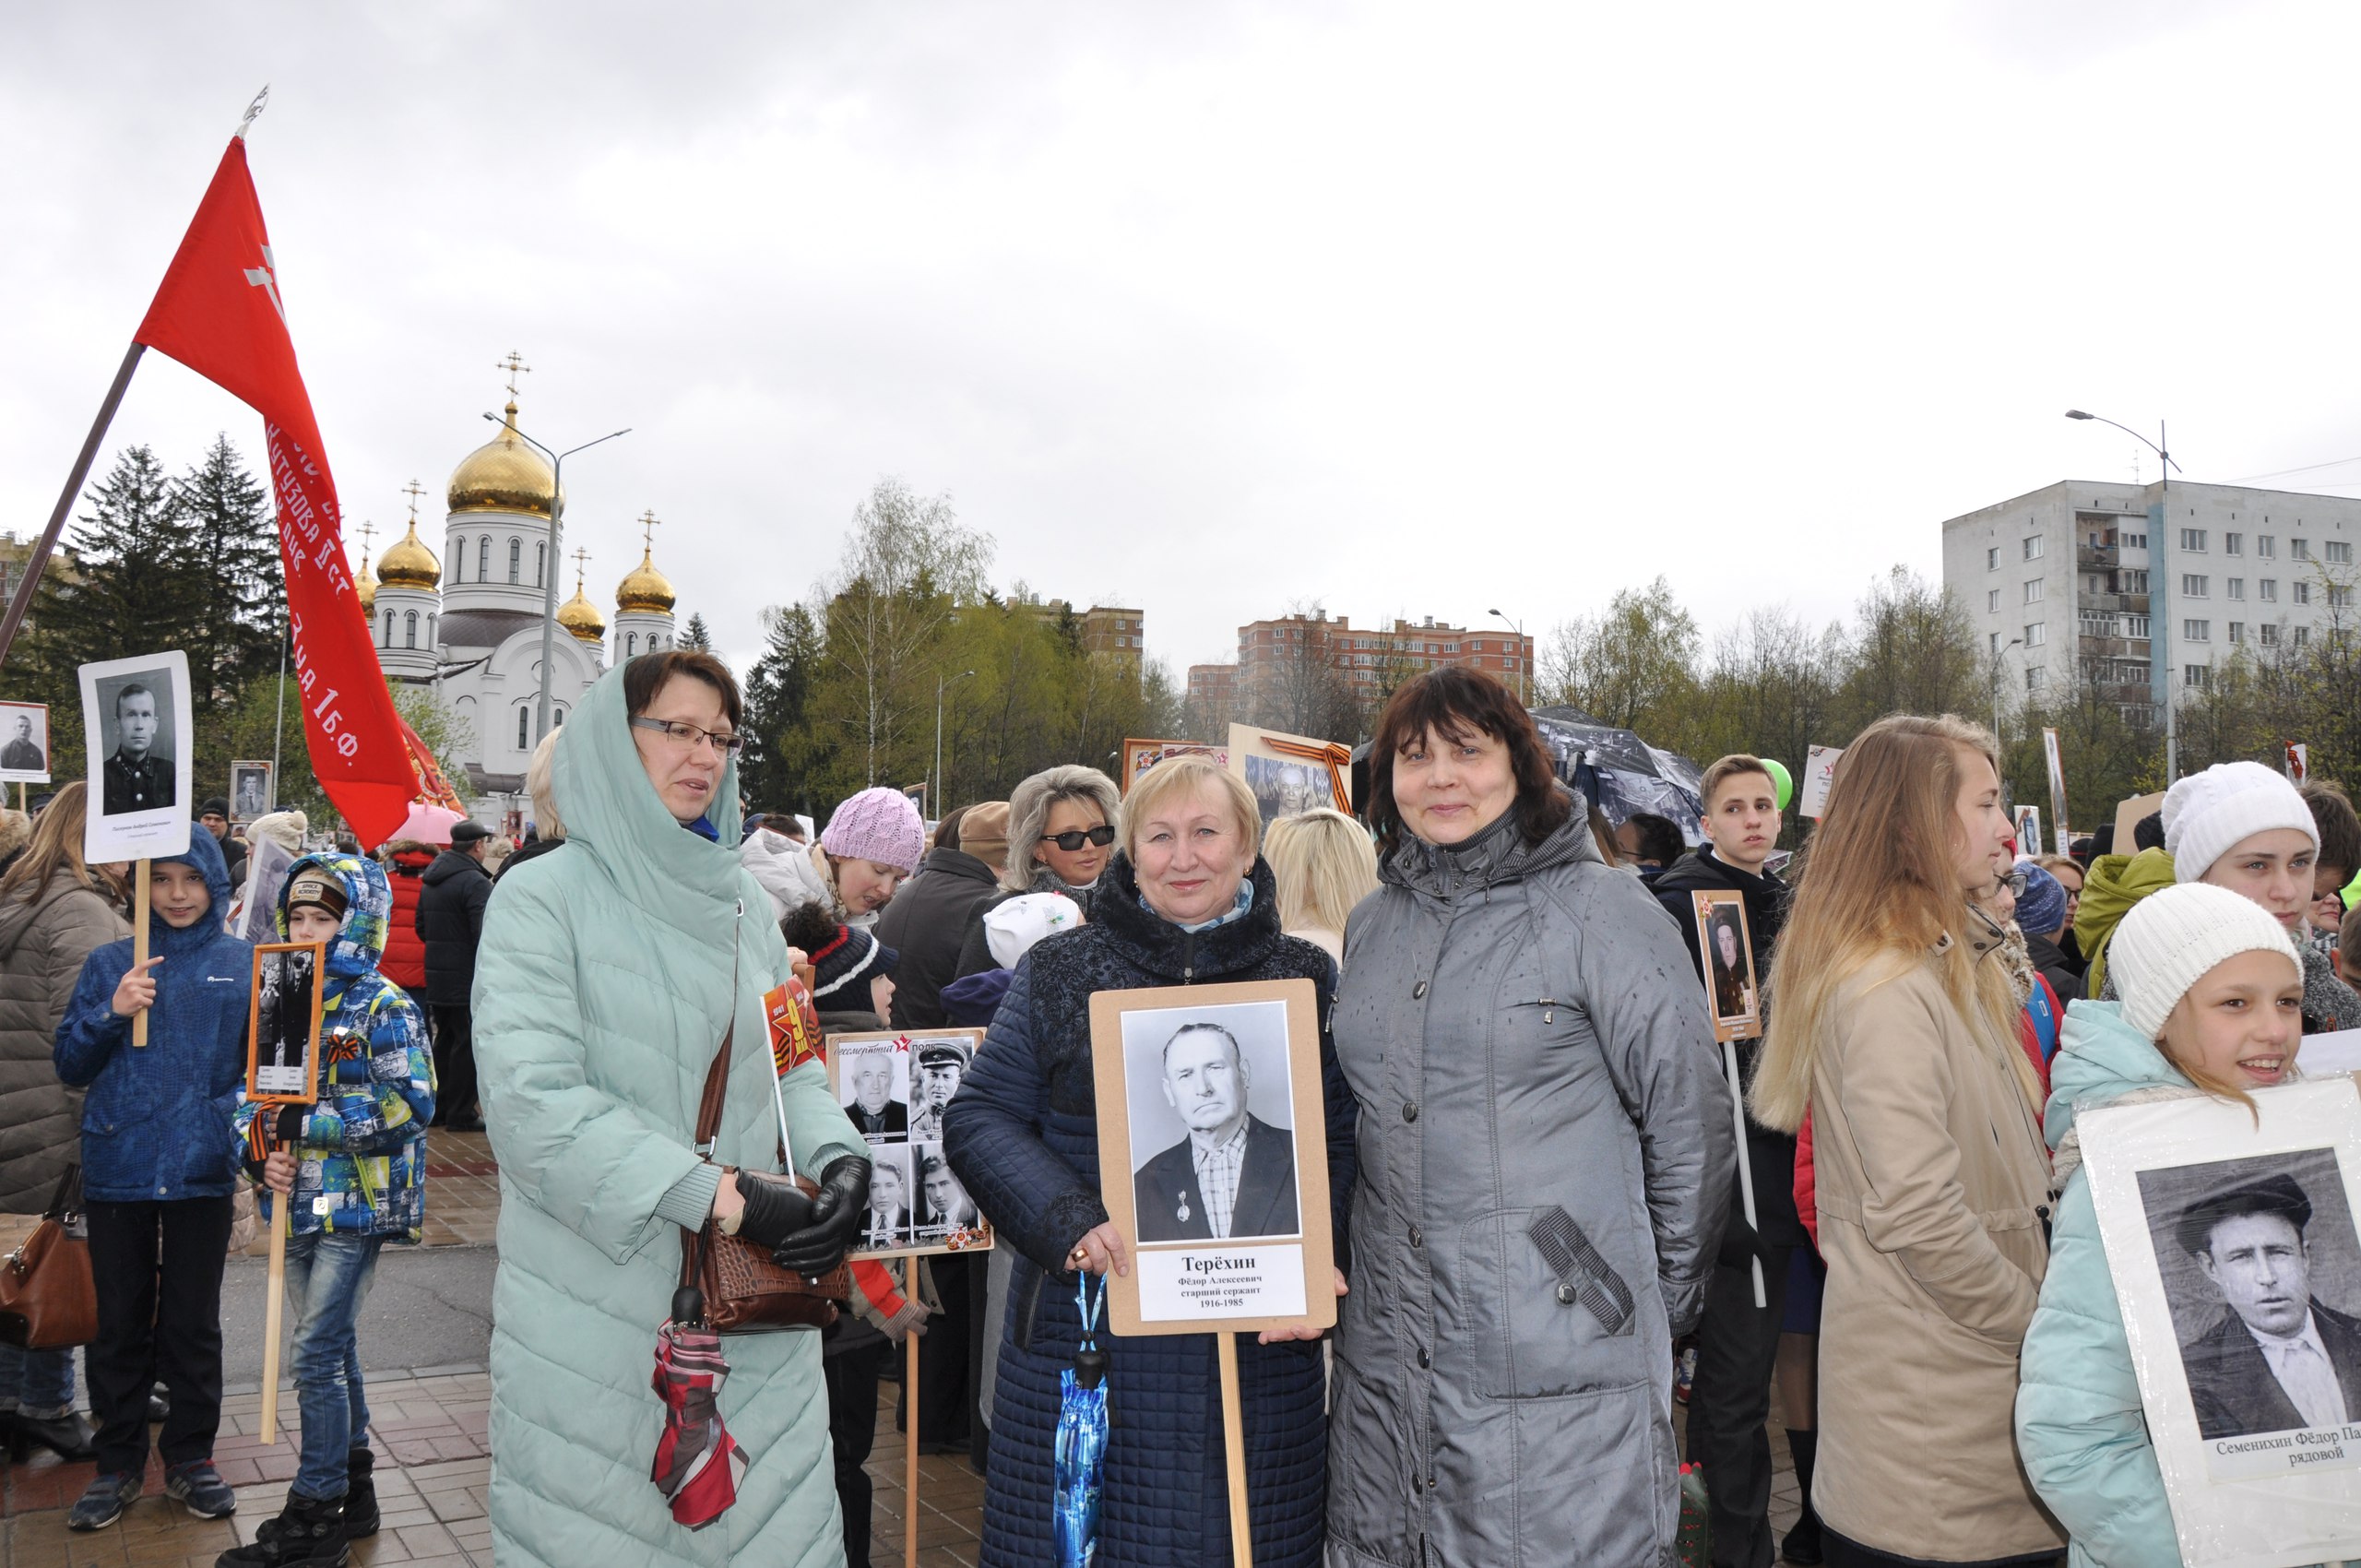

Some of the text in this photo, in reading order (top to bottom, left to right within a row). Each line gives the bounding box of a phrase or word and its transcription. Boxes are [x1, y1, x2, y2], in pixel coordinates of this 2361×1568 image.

[787, 997, 804, 1041] 9
[1181, 1255, 1256, 1275] Терёхин
[1178, 1276, 1263, 1287] Фёдор Алексеевич
[1180, 1288, 1262, 1299] старший сержант
[1200, 1298, 1244, 1308] 1916-1985
[2216, 1436, 2293, 1455] Семенихин
[2295, 1431, 2340, 1445] Фёдор
[2288, 1445, 2344, 1467] рядовой
